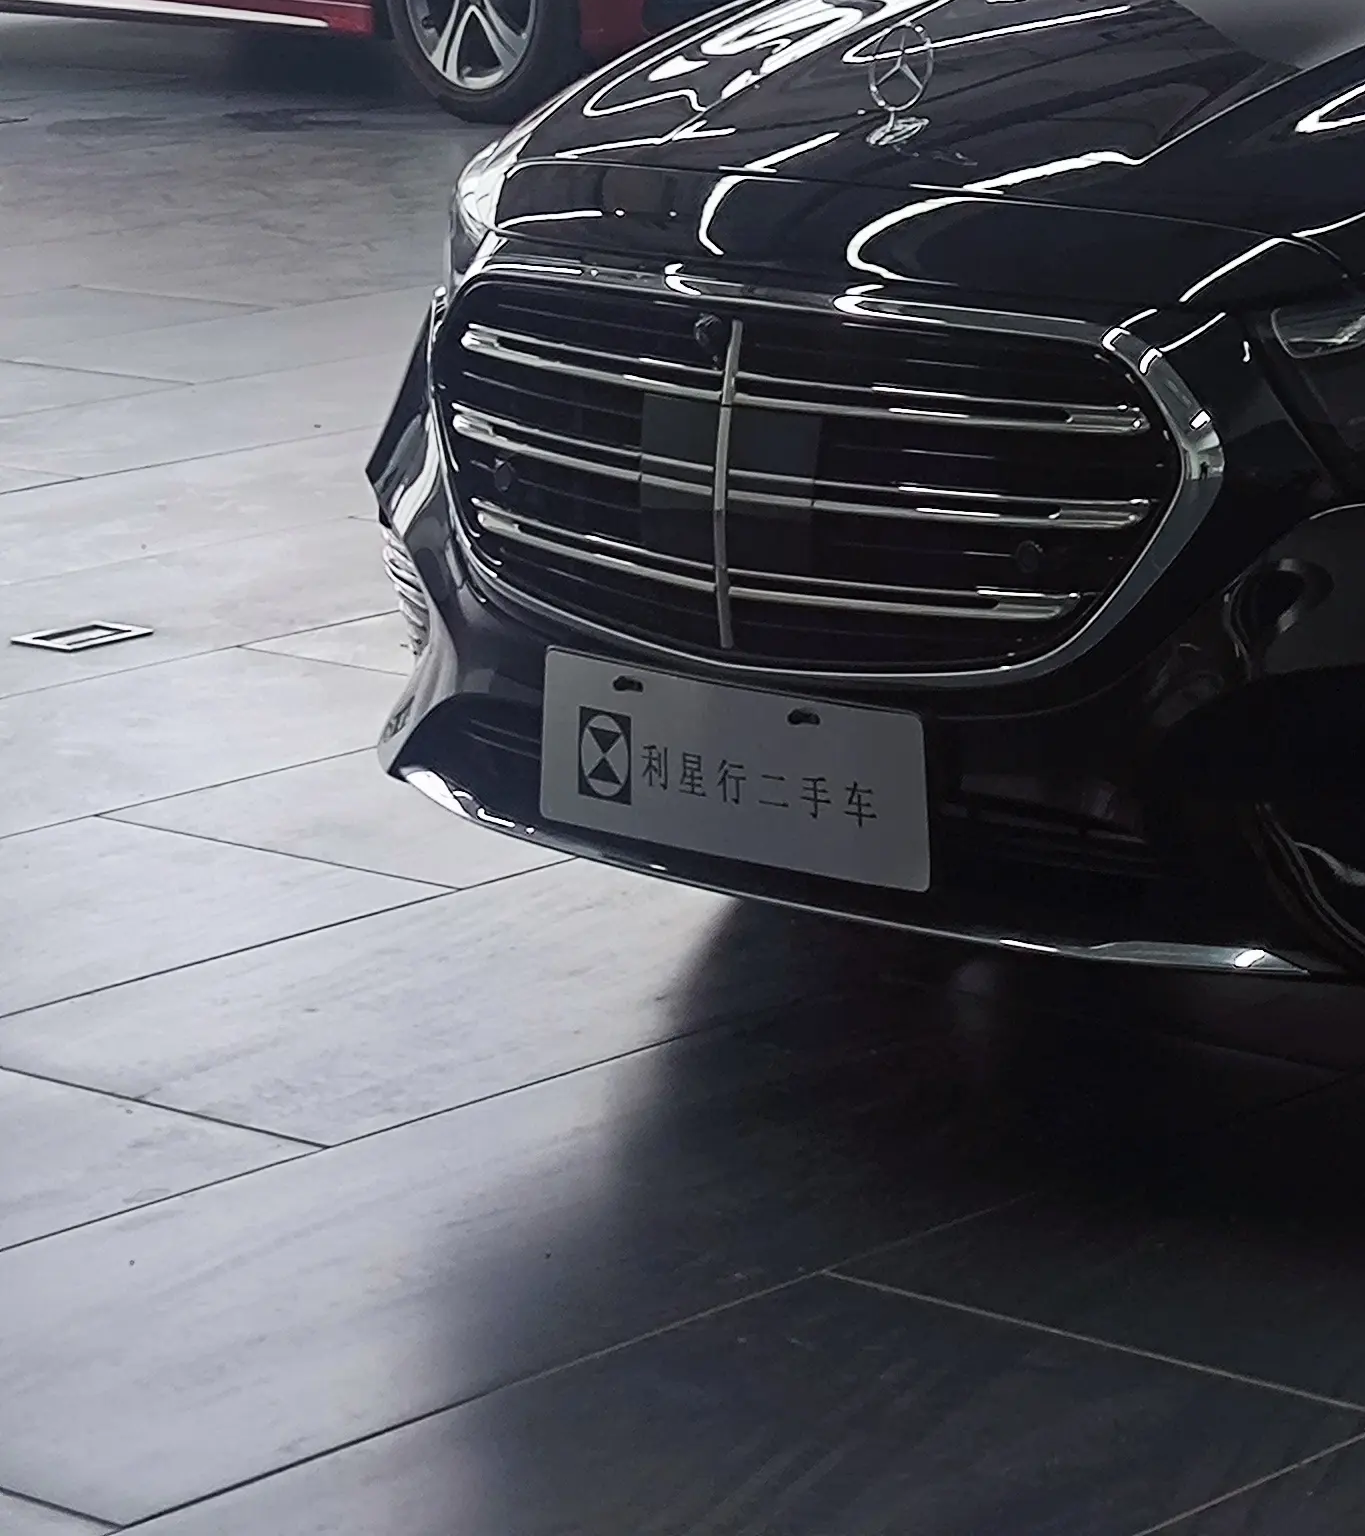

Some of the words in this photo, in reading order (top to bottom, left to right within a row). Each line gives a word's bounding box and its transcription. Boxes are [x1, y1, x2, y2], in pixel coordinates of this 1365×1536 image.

[641, 744, 877, 828] 利星行二手车
